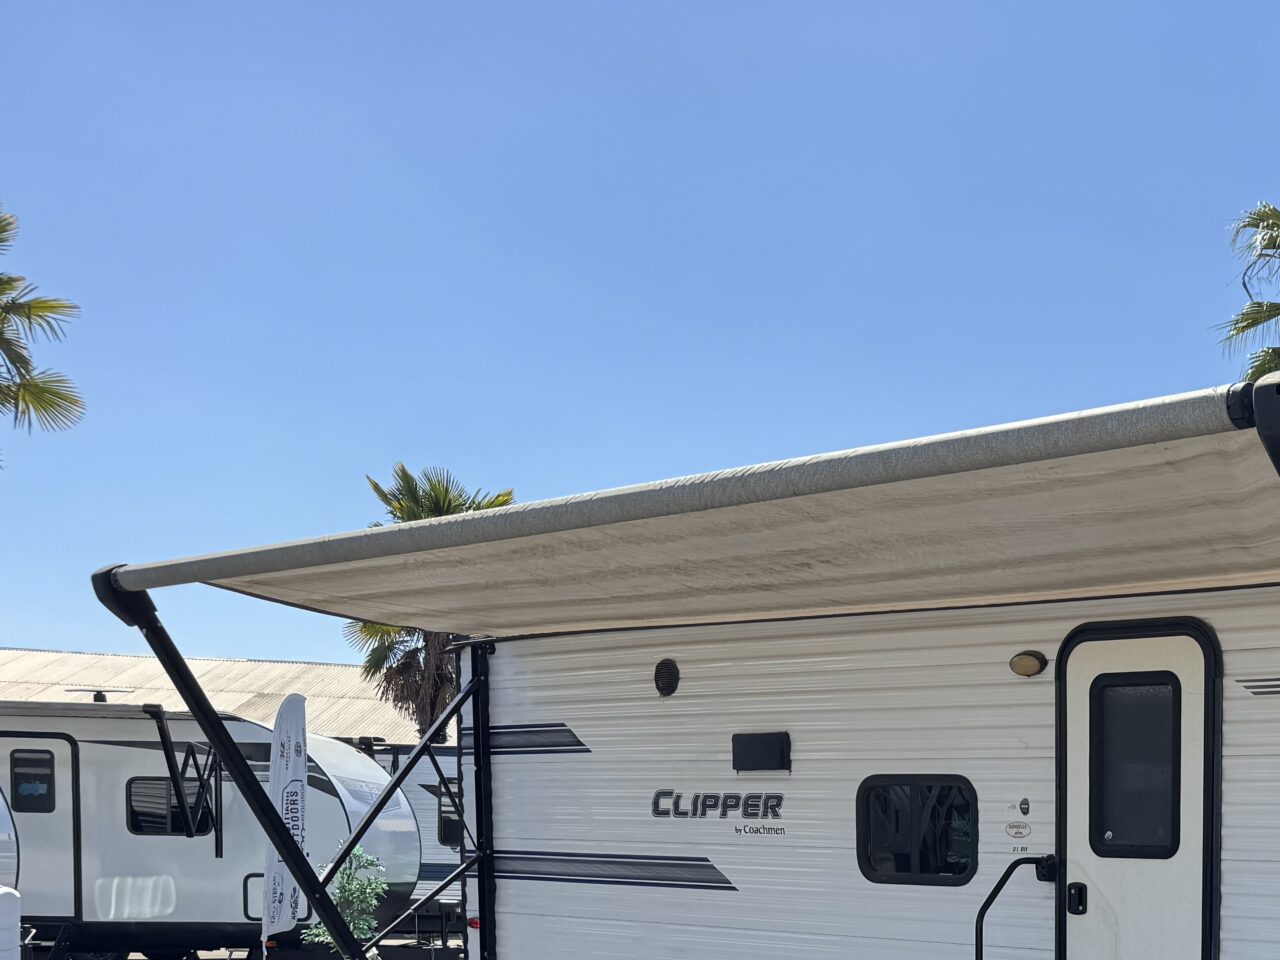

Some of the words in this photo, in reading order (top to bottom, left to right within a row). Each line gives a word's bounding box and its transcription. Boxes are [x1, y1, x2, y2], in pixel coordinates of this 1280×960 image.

[289, 790, 300, 846] TDOORS
[652, 789, 785, 819] CLIPPER
[735, 826, 742, 835] by
[743, 825, 786, 835] Coachmen
